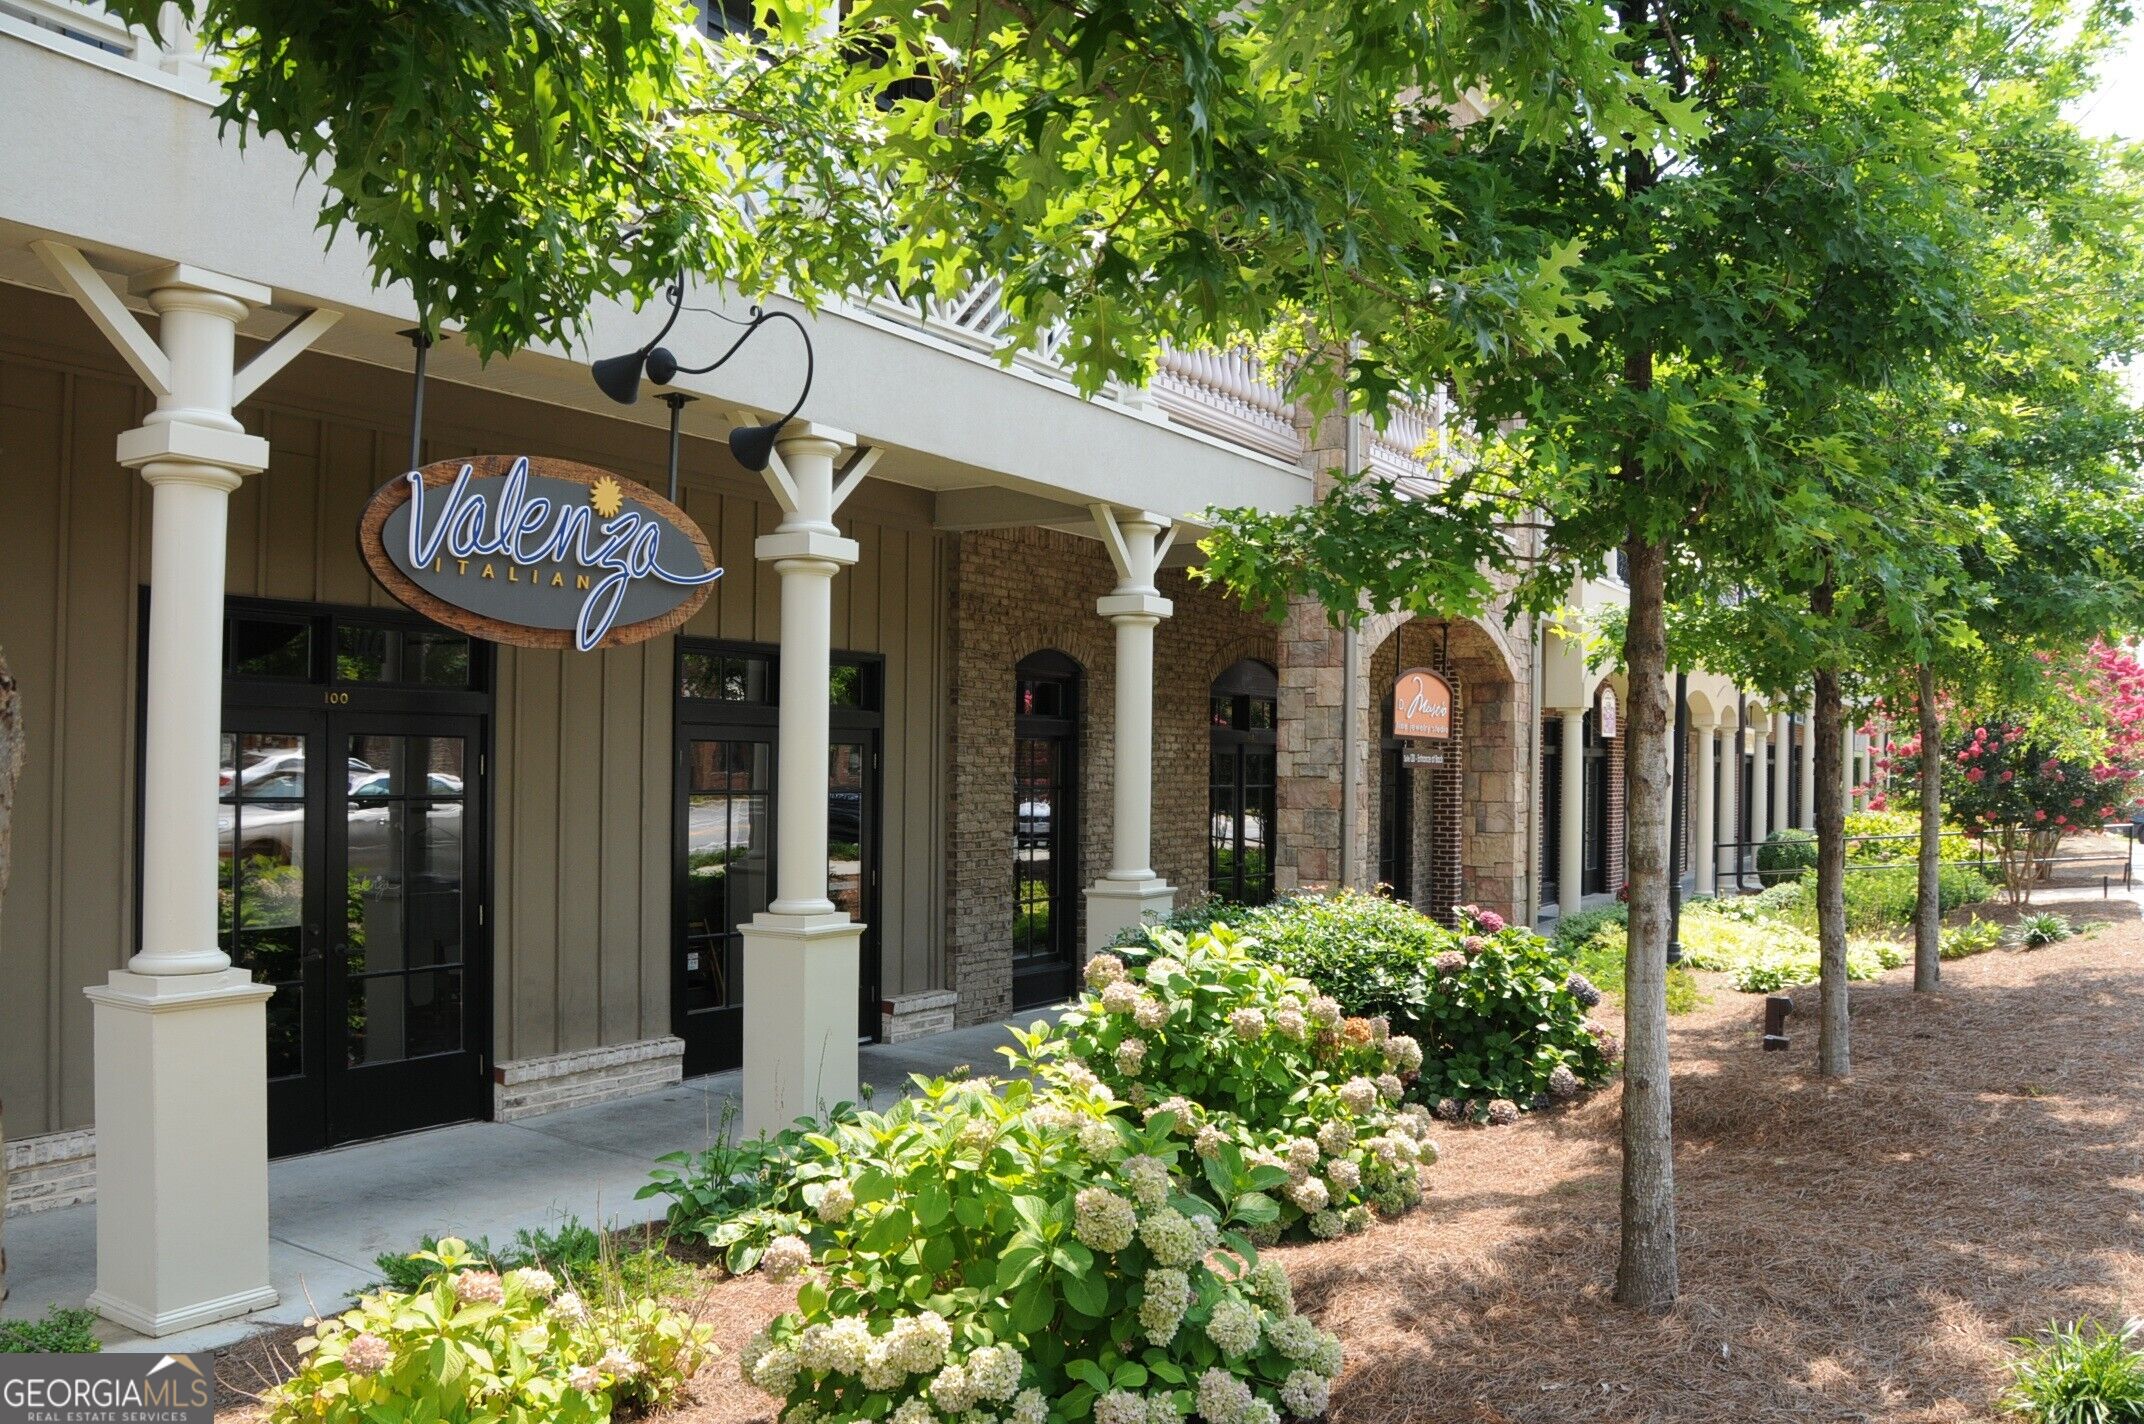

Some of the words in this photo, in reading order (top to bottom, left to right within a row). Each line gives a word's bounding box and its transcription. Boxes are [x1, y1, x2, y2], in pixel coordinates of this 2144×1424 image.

[407, 456, 724, 651] Valenza
[434, 557, 591, 590] ITALIAN
[324, 691, 349, 704] 100
